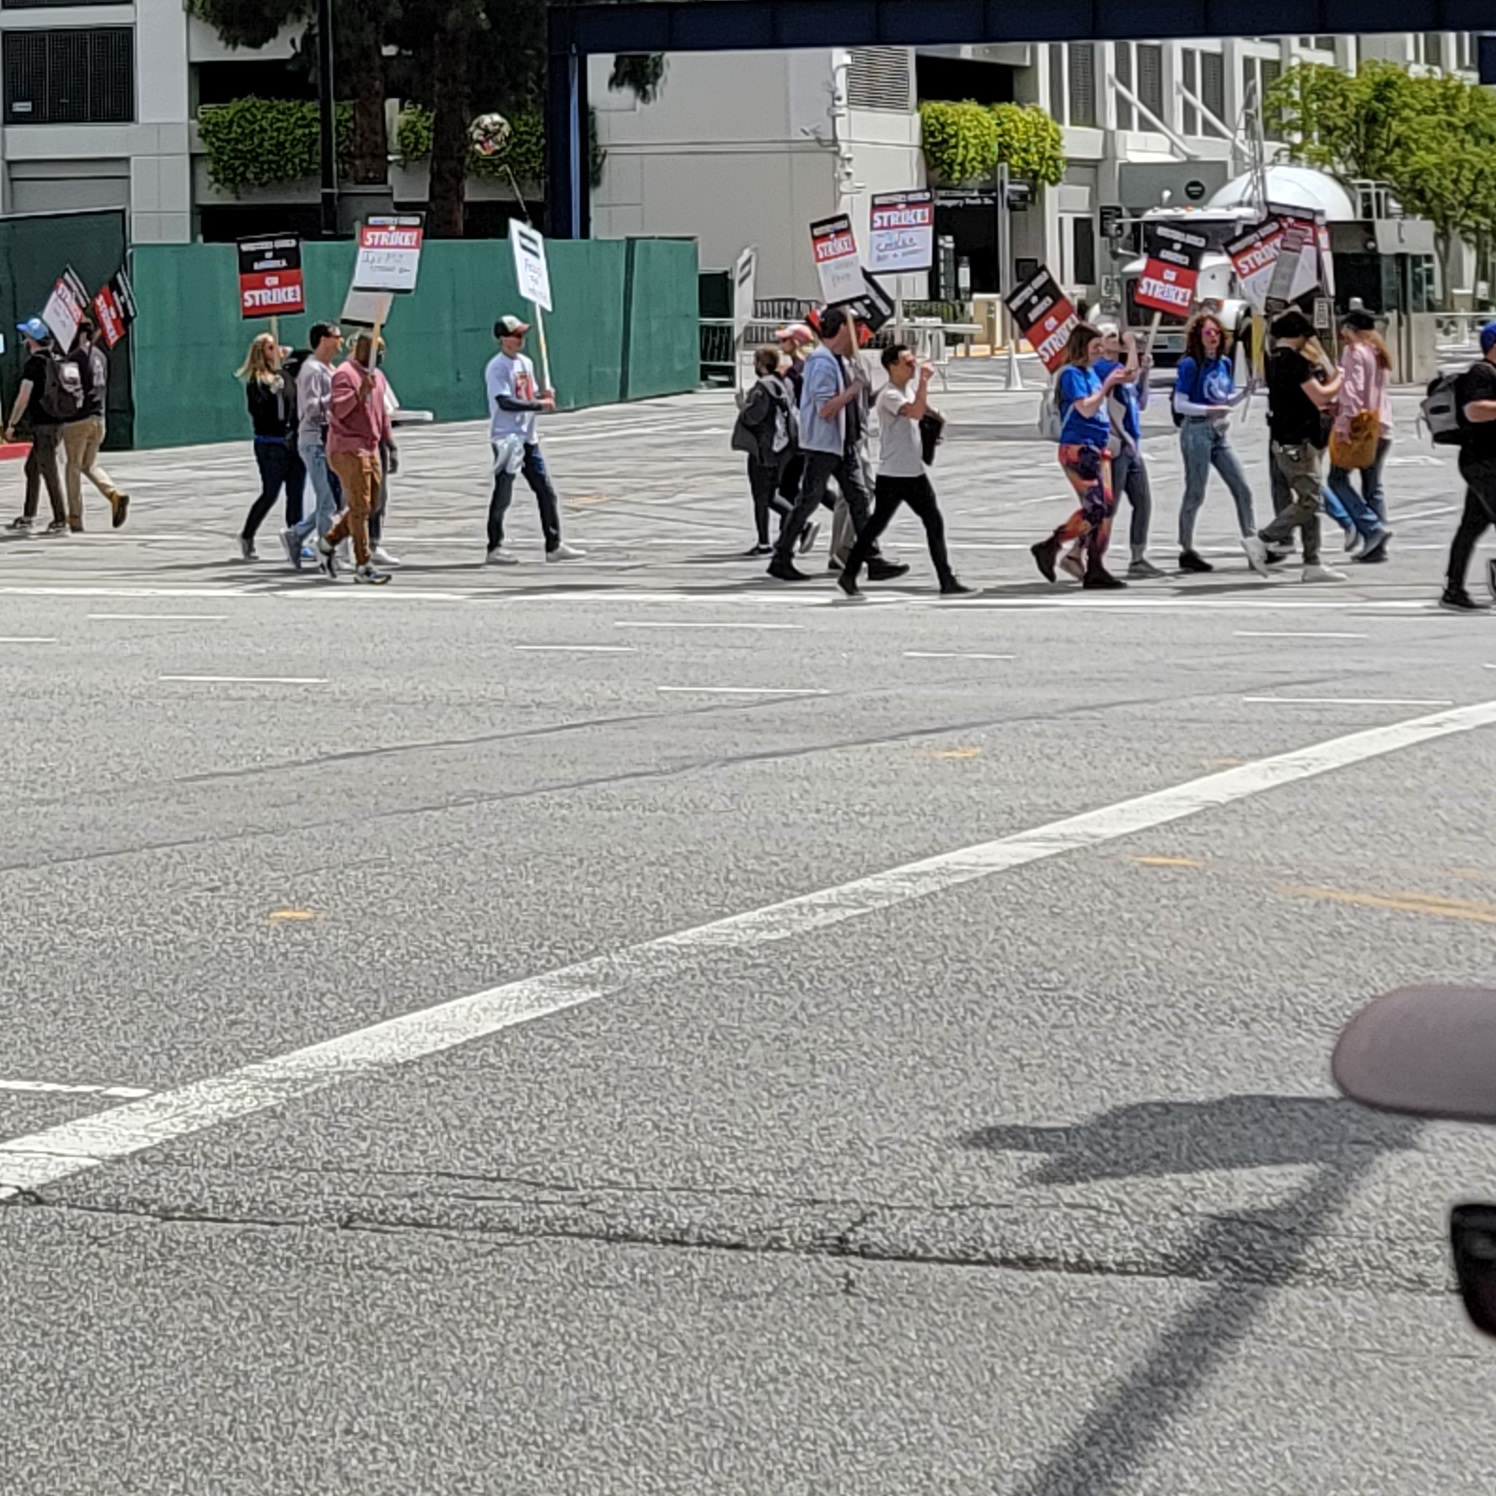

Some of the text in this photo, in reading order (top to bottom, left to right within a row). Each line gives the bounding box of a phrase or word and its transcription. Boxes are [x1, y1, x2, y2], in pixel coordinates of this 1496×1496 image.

[364, 231, 419, 247] STRIKE!
[244, 284, 302, 308] STRIKE!
[1138, 277, 1192, 308] STRIKE!
